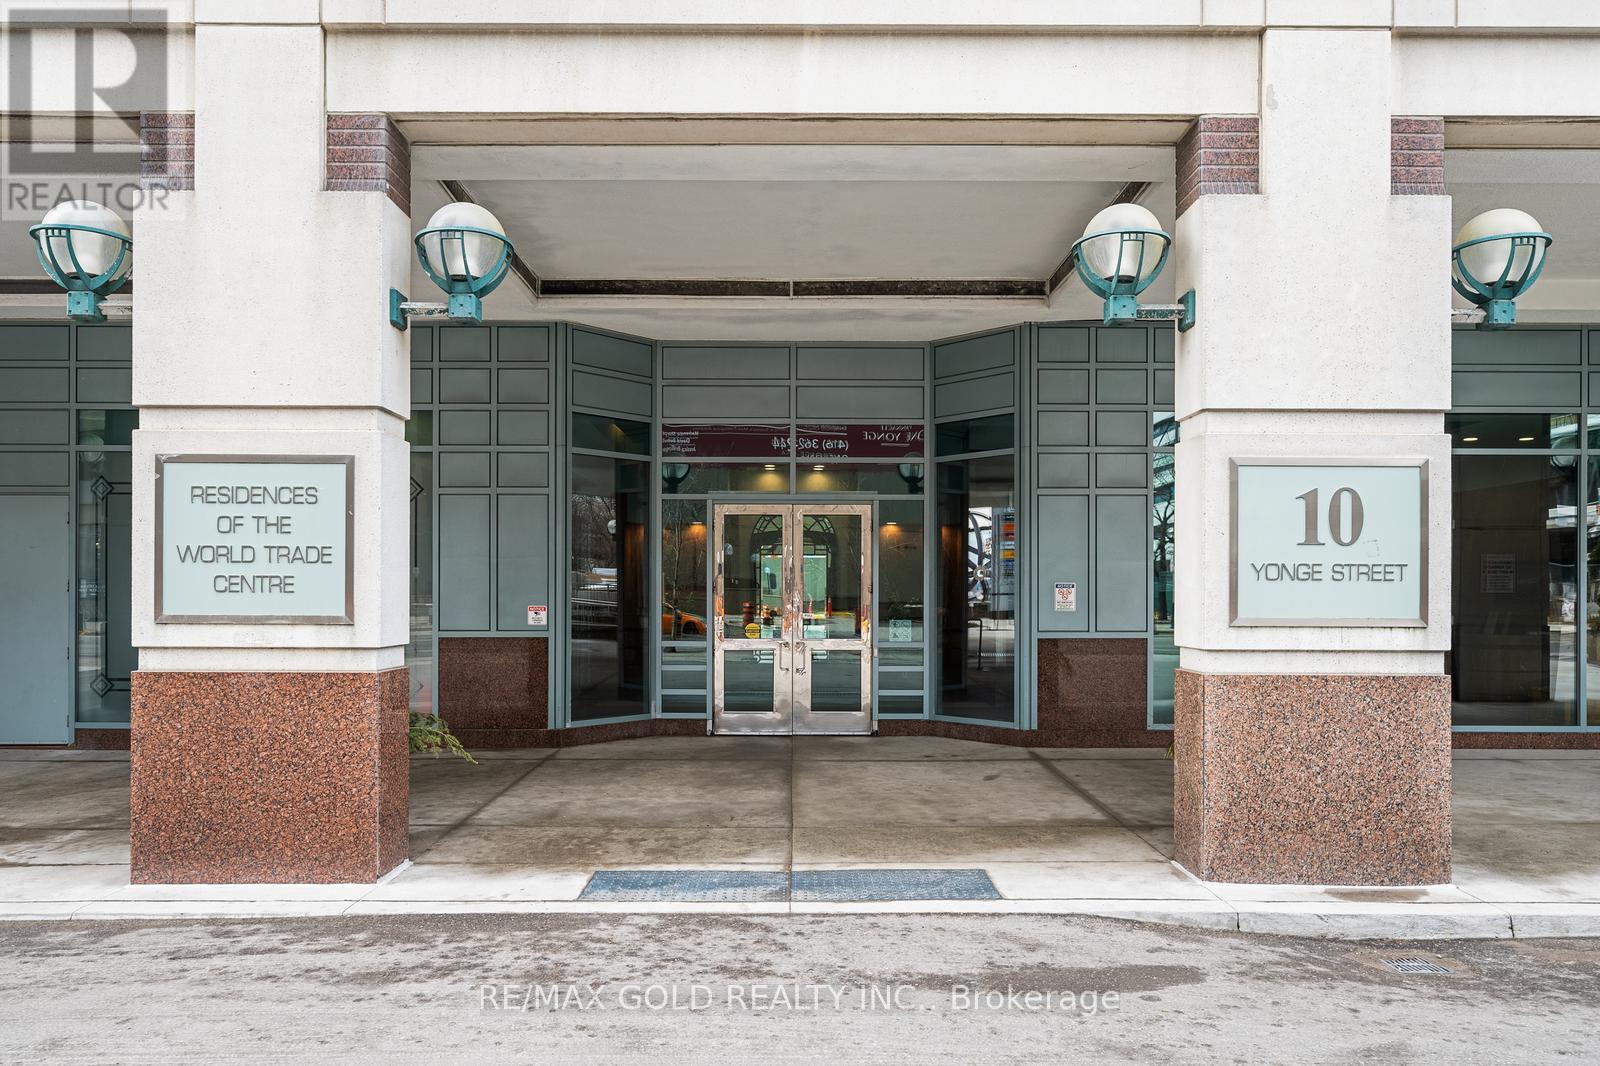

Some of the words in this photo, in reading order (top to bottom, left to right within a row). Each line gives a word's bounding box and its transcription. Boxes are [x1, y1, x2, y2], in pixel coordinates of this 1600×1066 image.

[191, 486, 318, 505] RESIDENCES
[217, 516, 244, 534] OF
[252, 516, 291, 534] THE
[1295, 487, 1364, 546] 10
[176, 545, 255, 564] WORLD
[264, 546, 333, 564] TRADE
[1251, 563, 1323, 582] YONGE
[1331, 563, 1408, 582] STREET
[213, 575, 295, 593] CENTRE
